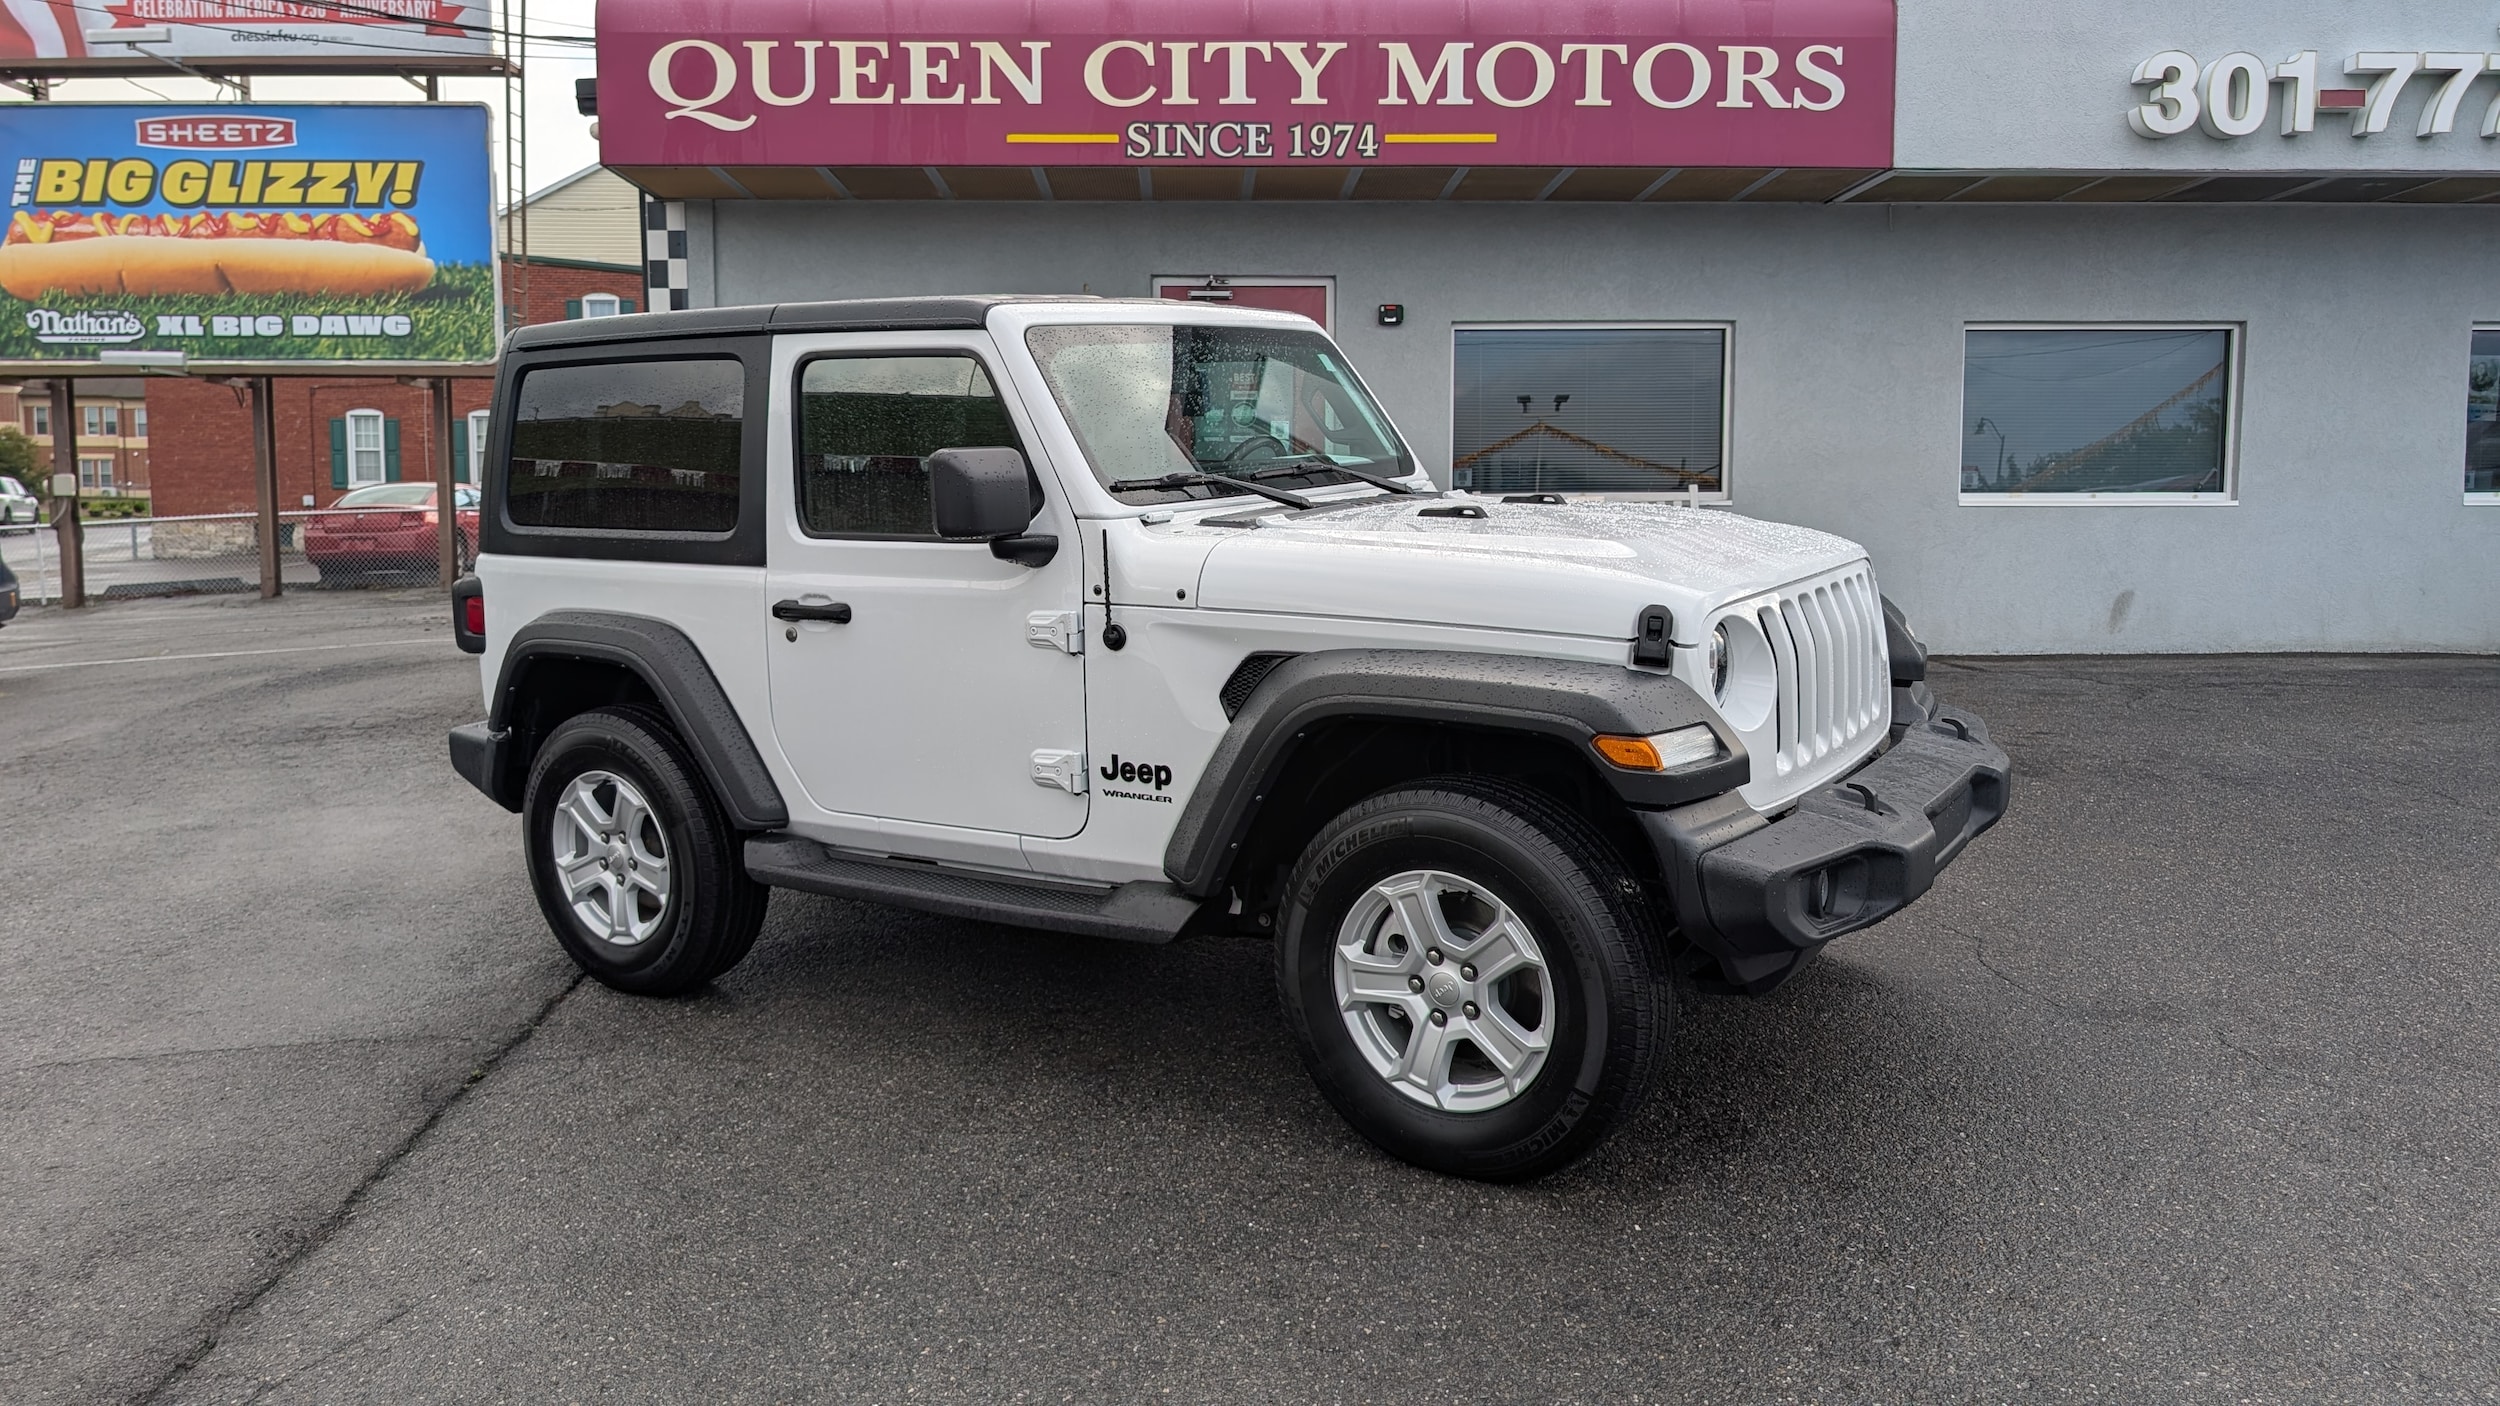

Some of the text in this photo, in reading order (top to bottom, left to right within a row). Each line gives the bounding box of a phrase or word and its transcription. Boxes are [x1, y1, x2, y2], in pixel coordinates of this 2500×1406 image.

[133, 0, 223, 18] CELEBRATING
[225, 0, 298, 18] AMERICA'S
[339, 0, 437, 19] ANNIVERSARY!
[230, 29, 320, 46] chessiefcu.org
[648, 39, 1846, 132] QUEEN CITY MOTORS
[147, 123, 285, 143] SHEETZ
[1125, 122, 1380, 160] SINCE 1974
[11, 159, 37, 206] THE
[35, 158, 421, 207] BIG GLIZZY!
[26, 309, 143, 337] Nathan's
[156, 316, 412, 337] XL BIG DAWG
[1233, 373, 1256, 382] BEST
[1100, 754, 1172, 790] Jeep
[1102, 789, 1173, 804] WRANGLER
[1315, 815, 1409, 877] MICHELIN
